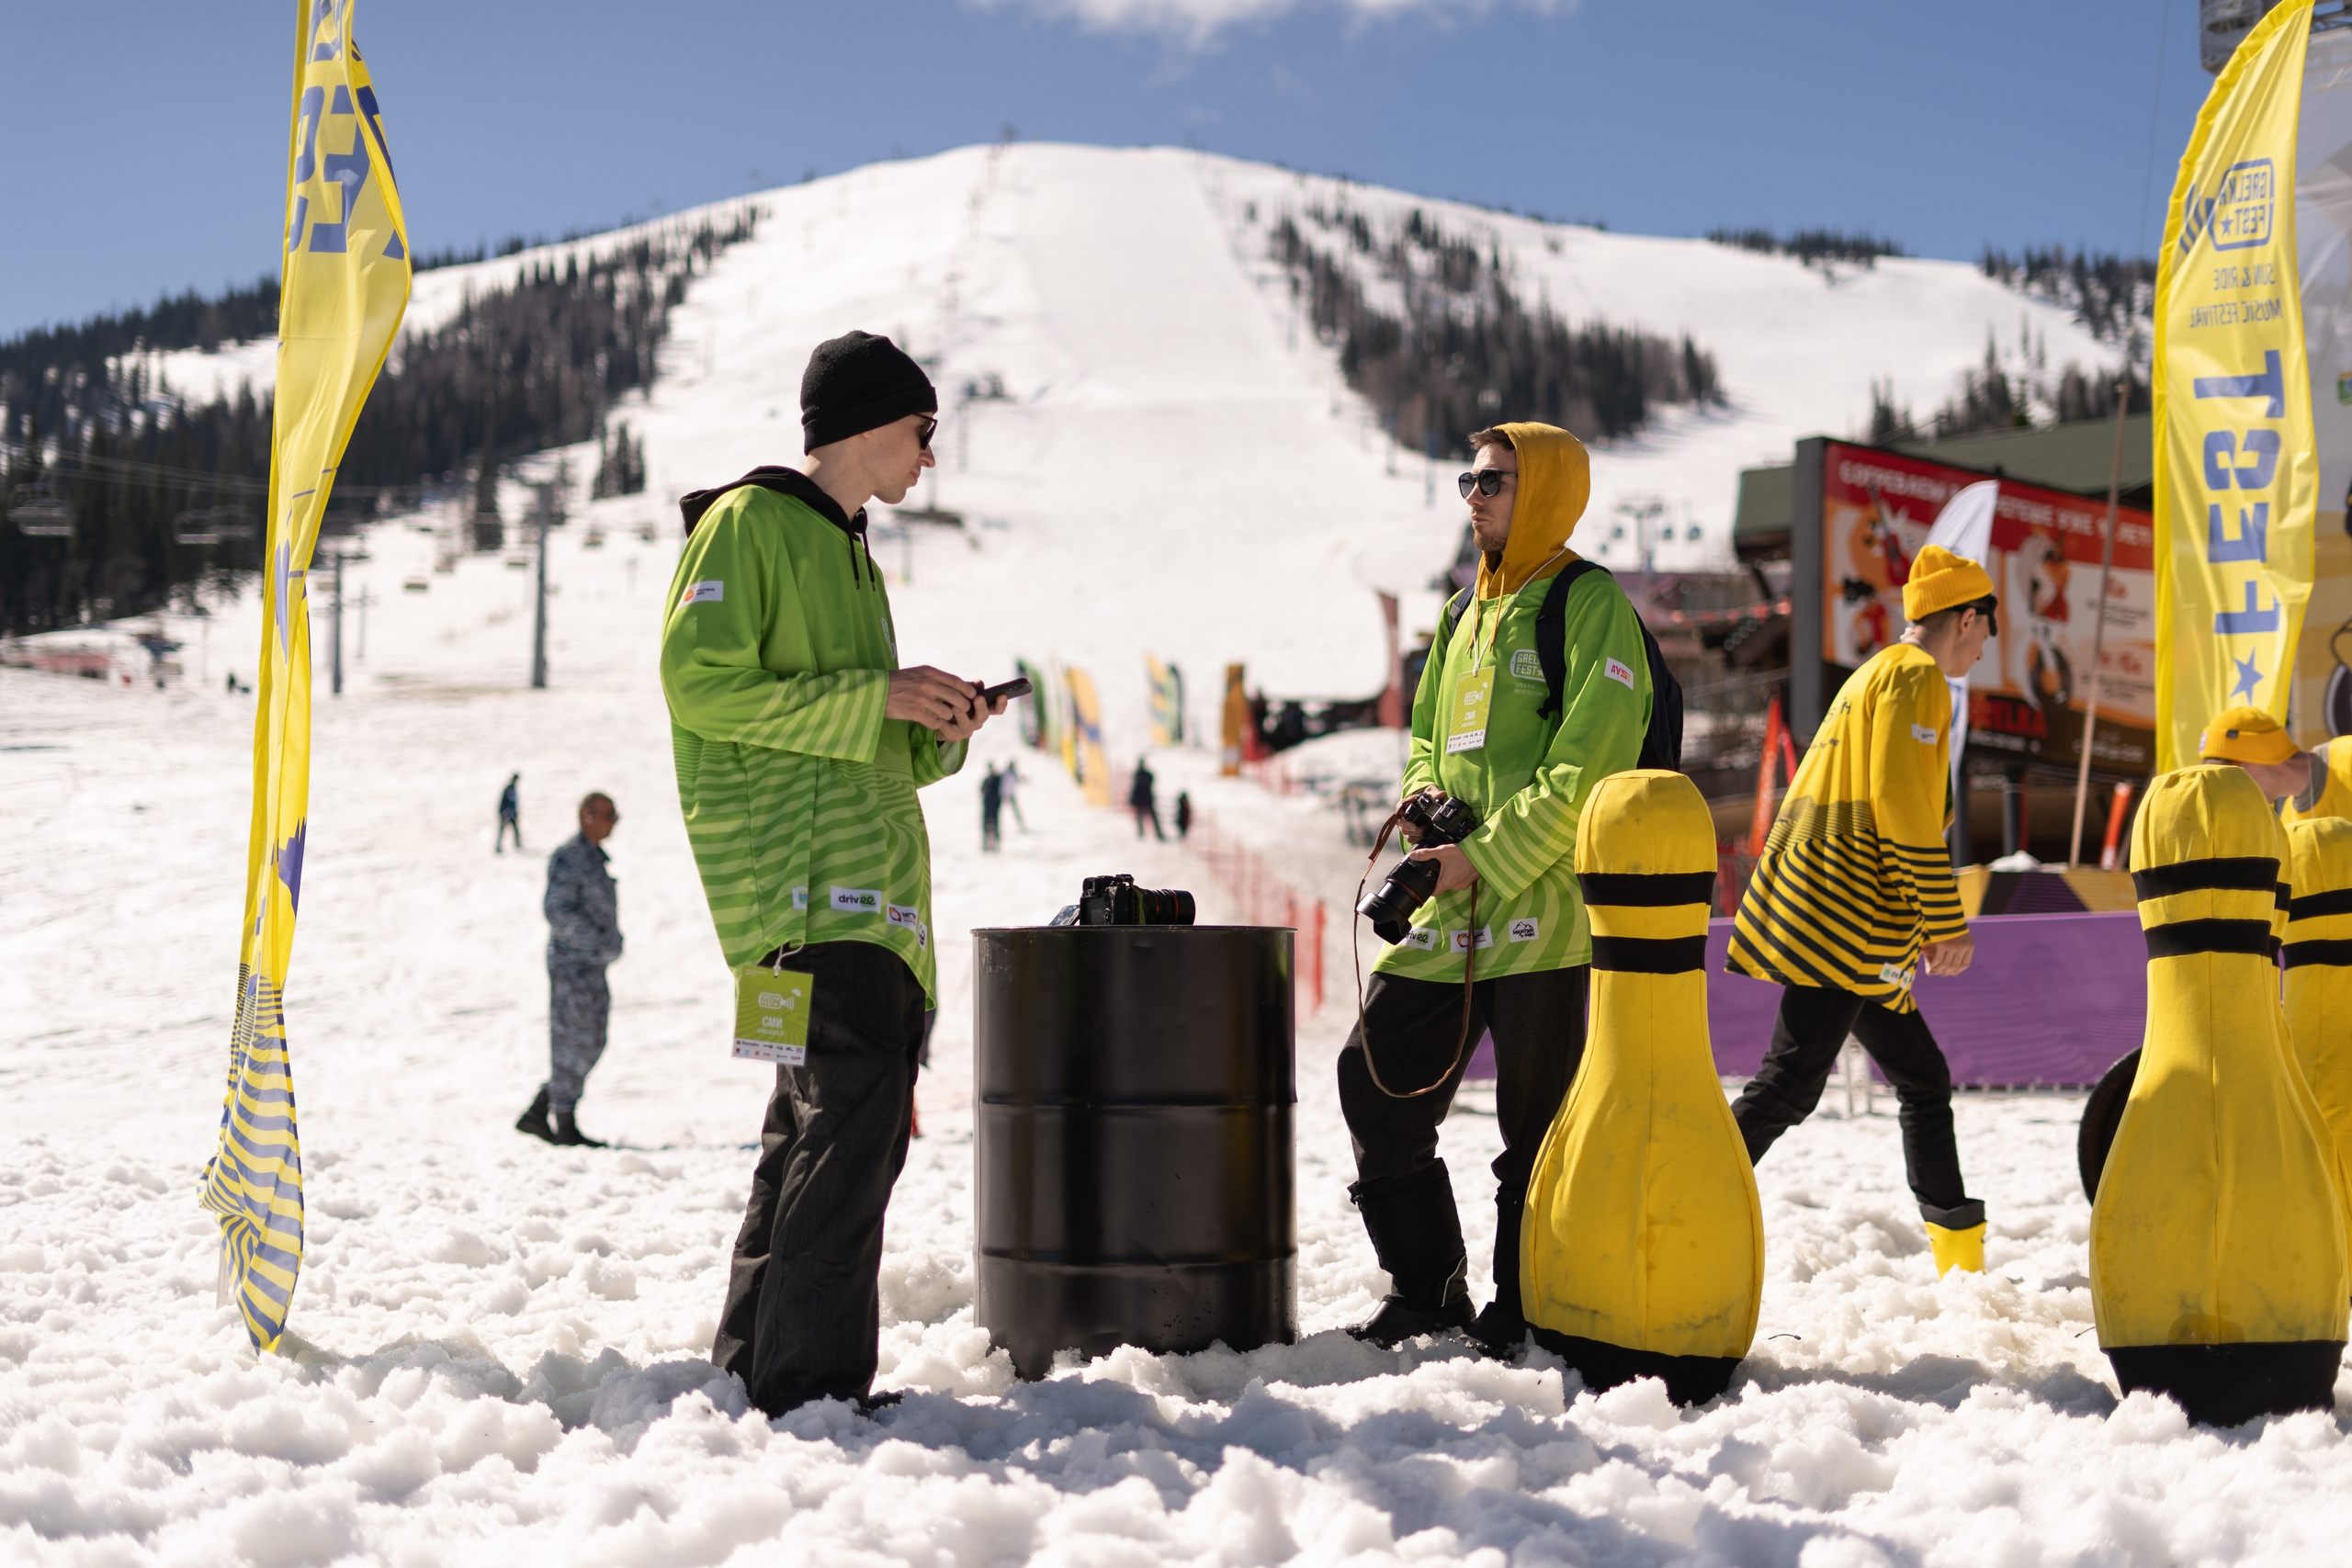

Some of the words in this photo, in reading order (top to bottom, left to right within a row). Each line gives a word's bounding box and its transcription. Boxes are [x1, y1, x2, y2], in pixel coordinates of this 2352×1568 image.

[1517, 653, 1541, 665] GREL
[1516, 664, 1538, 676] FEST
[1610, 664, 1631, 682] AYS!
[838, 894, 876, 906] drivee
[1405, 931, 1429, 943] rivee
[762, 1016, 783, 1028] СМИ
